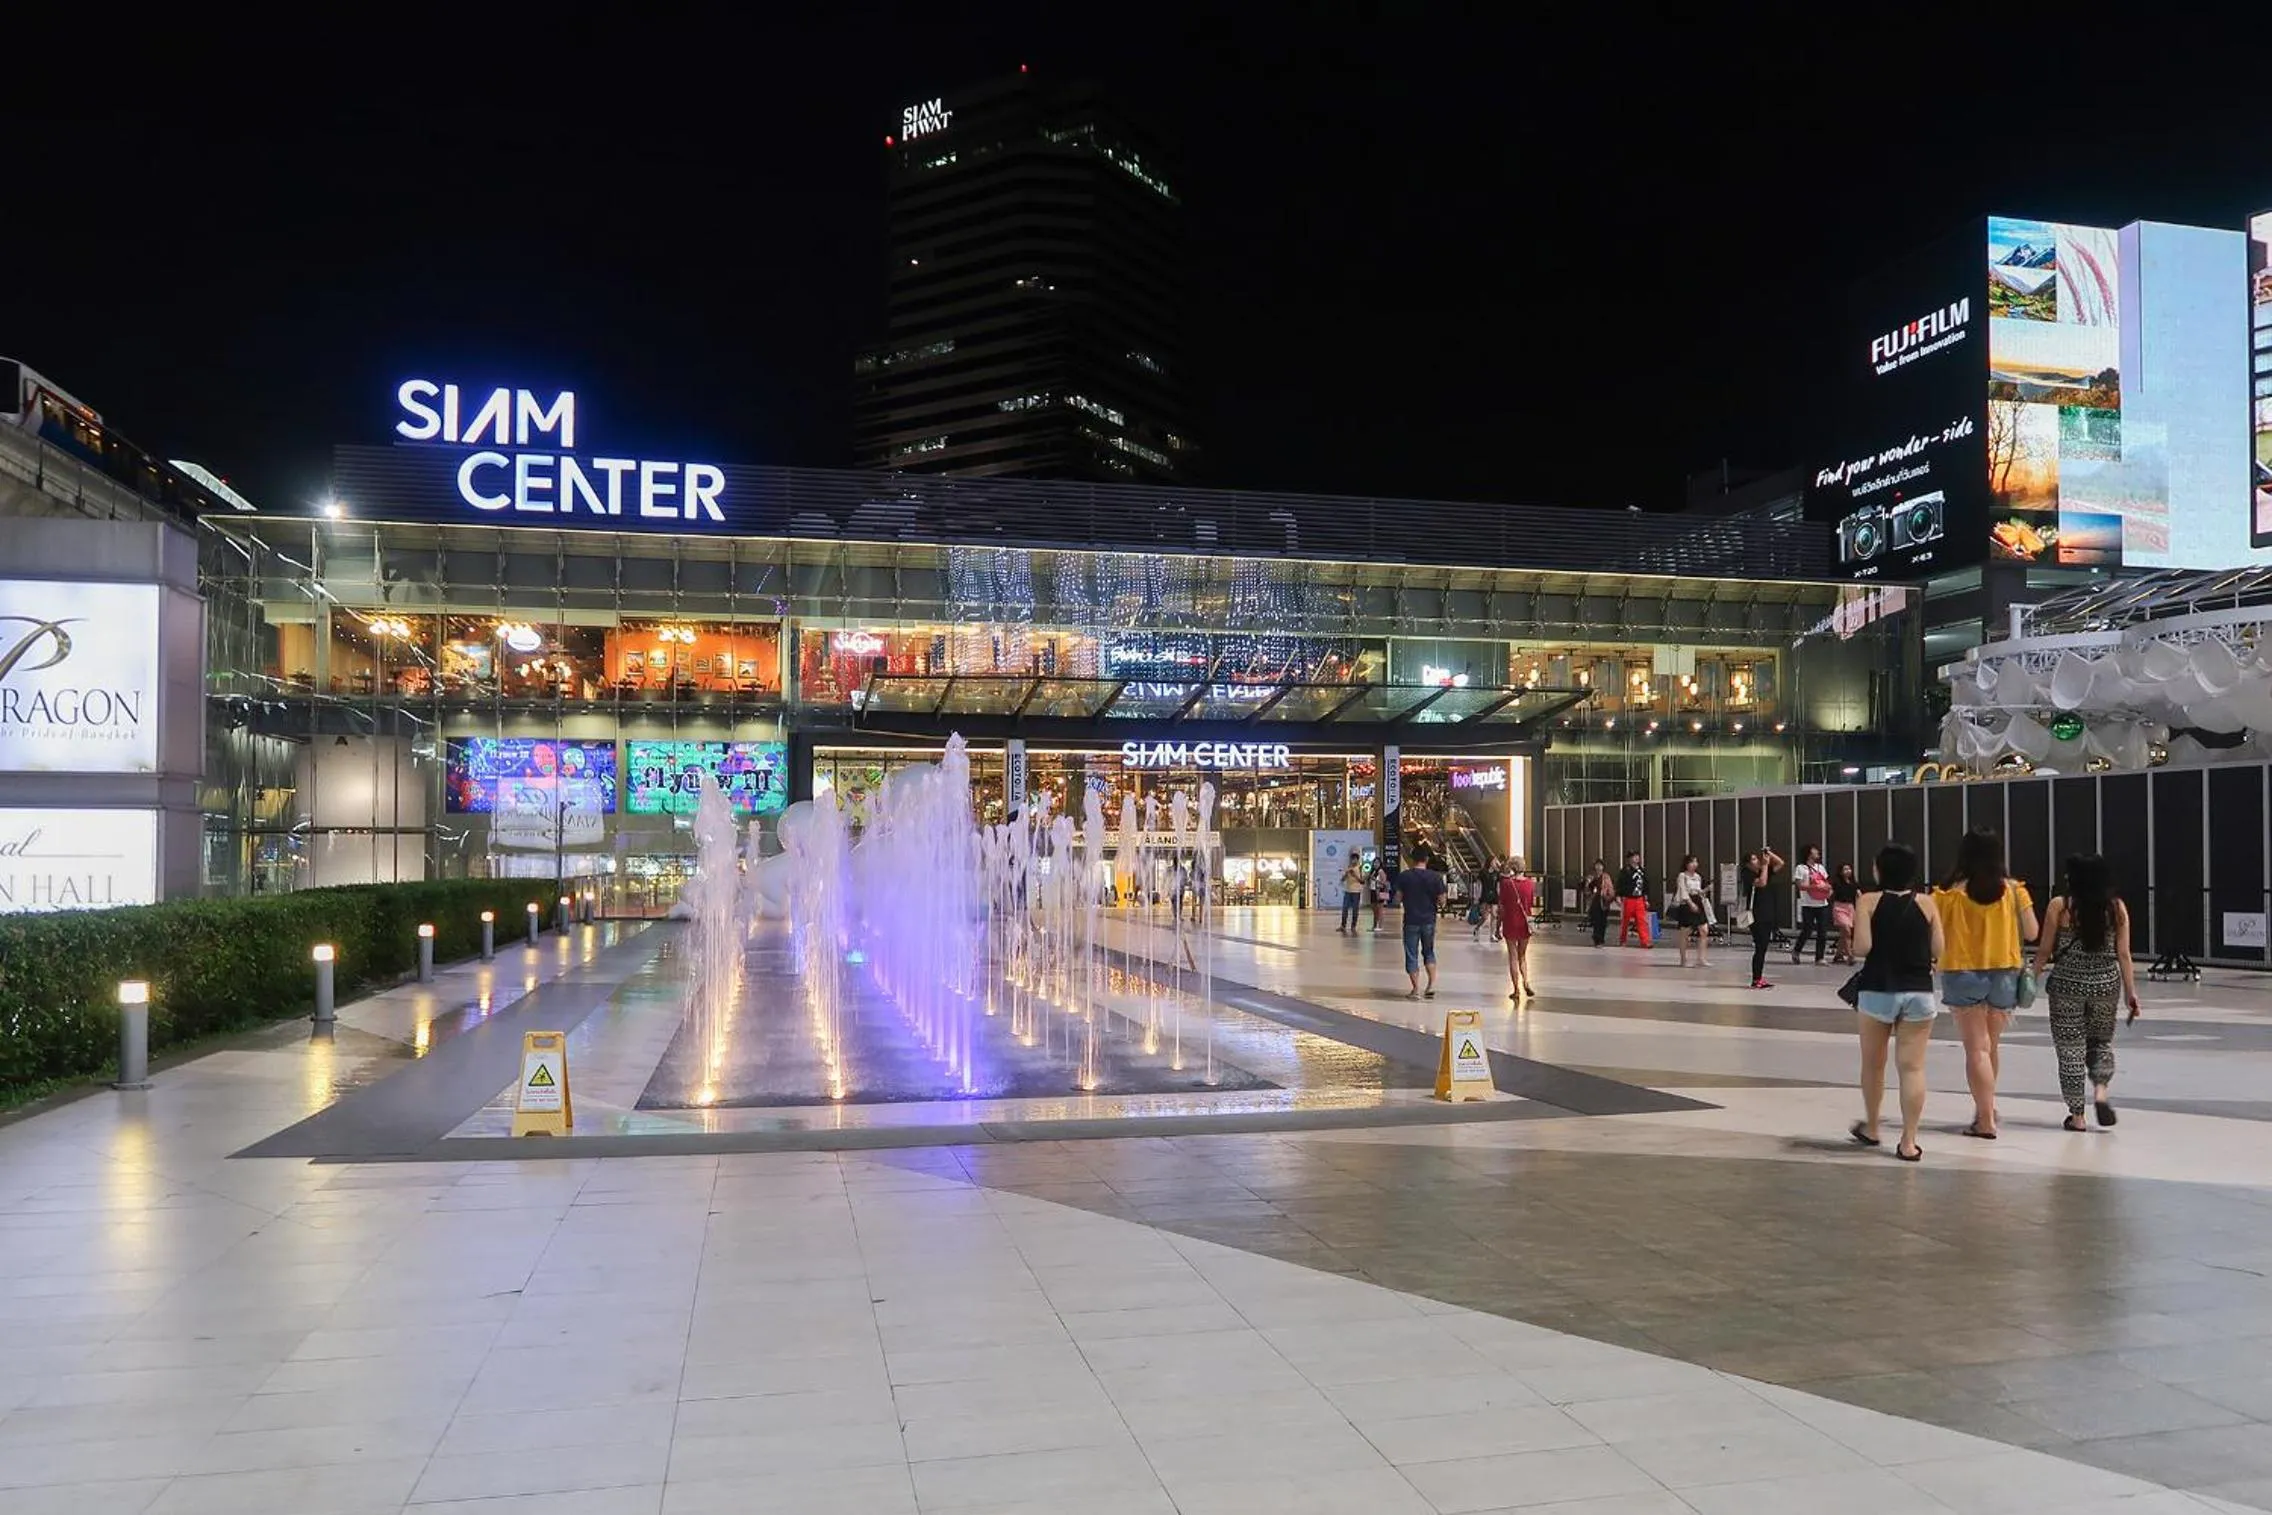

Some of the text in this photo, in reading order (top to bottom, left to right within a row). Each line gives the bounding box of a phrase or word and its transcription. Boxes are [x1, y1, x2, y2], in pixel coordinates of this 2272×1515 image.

[902, 110, 953, 141] PIWAT
[903, 98, 942, 124] SIAM
[396, 379, 576, 448] SIAM
[457, 451, 726, 521] CENTER
[1816, 461, 1846, 488] Find
[1845, 454, 1875, 486] your
[0, 687, 142, 727] RAGON
[1122, 742, 1291, 768] SIAM CENTER
[644, 766, 735, 794] flynw
